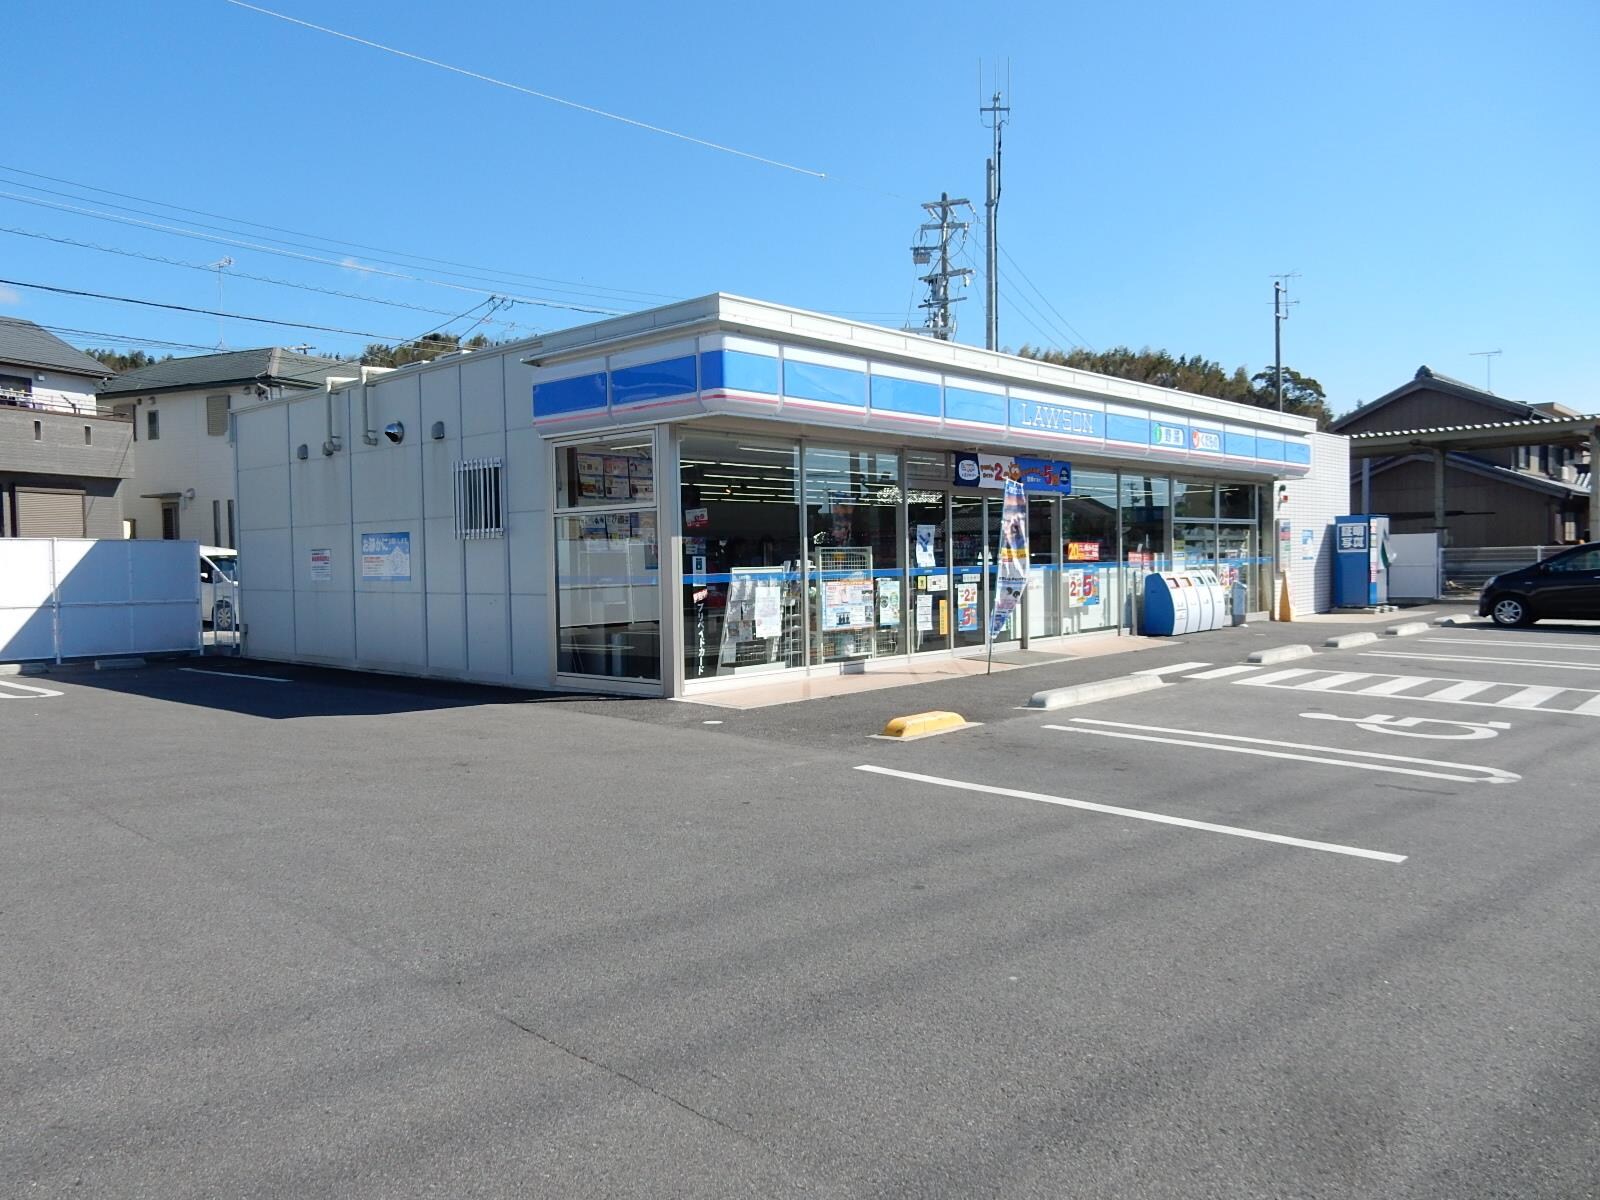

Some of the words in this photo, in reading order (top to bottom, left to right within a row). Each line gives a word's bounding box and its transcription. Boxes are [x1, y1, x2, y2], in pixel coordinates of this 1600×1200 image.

[1021, 403, 1094, 434] LAWSON
[1341, 526, 1365, 537] 証明
[1341, 537, 1365, 549] 写真
